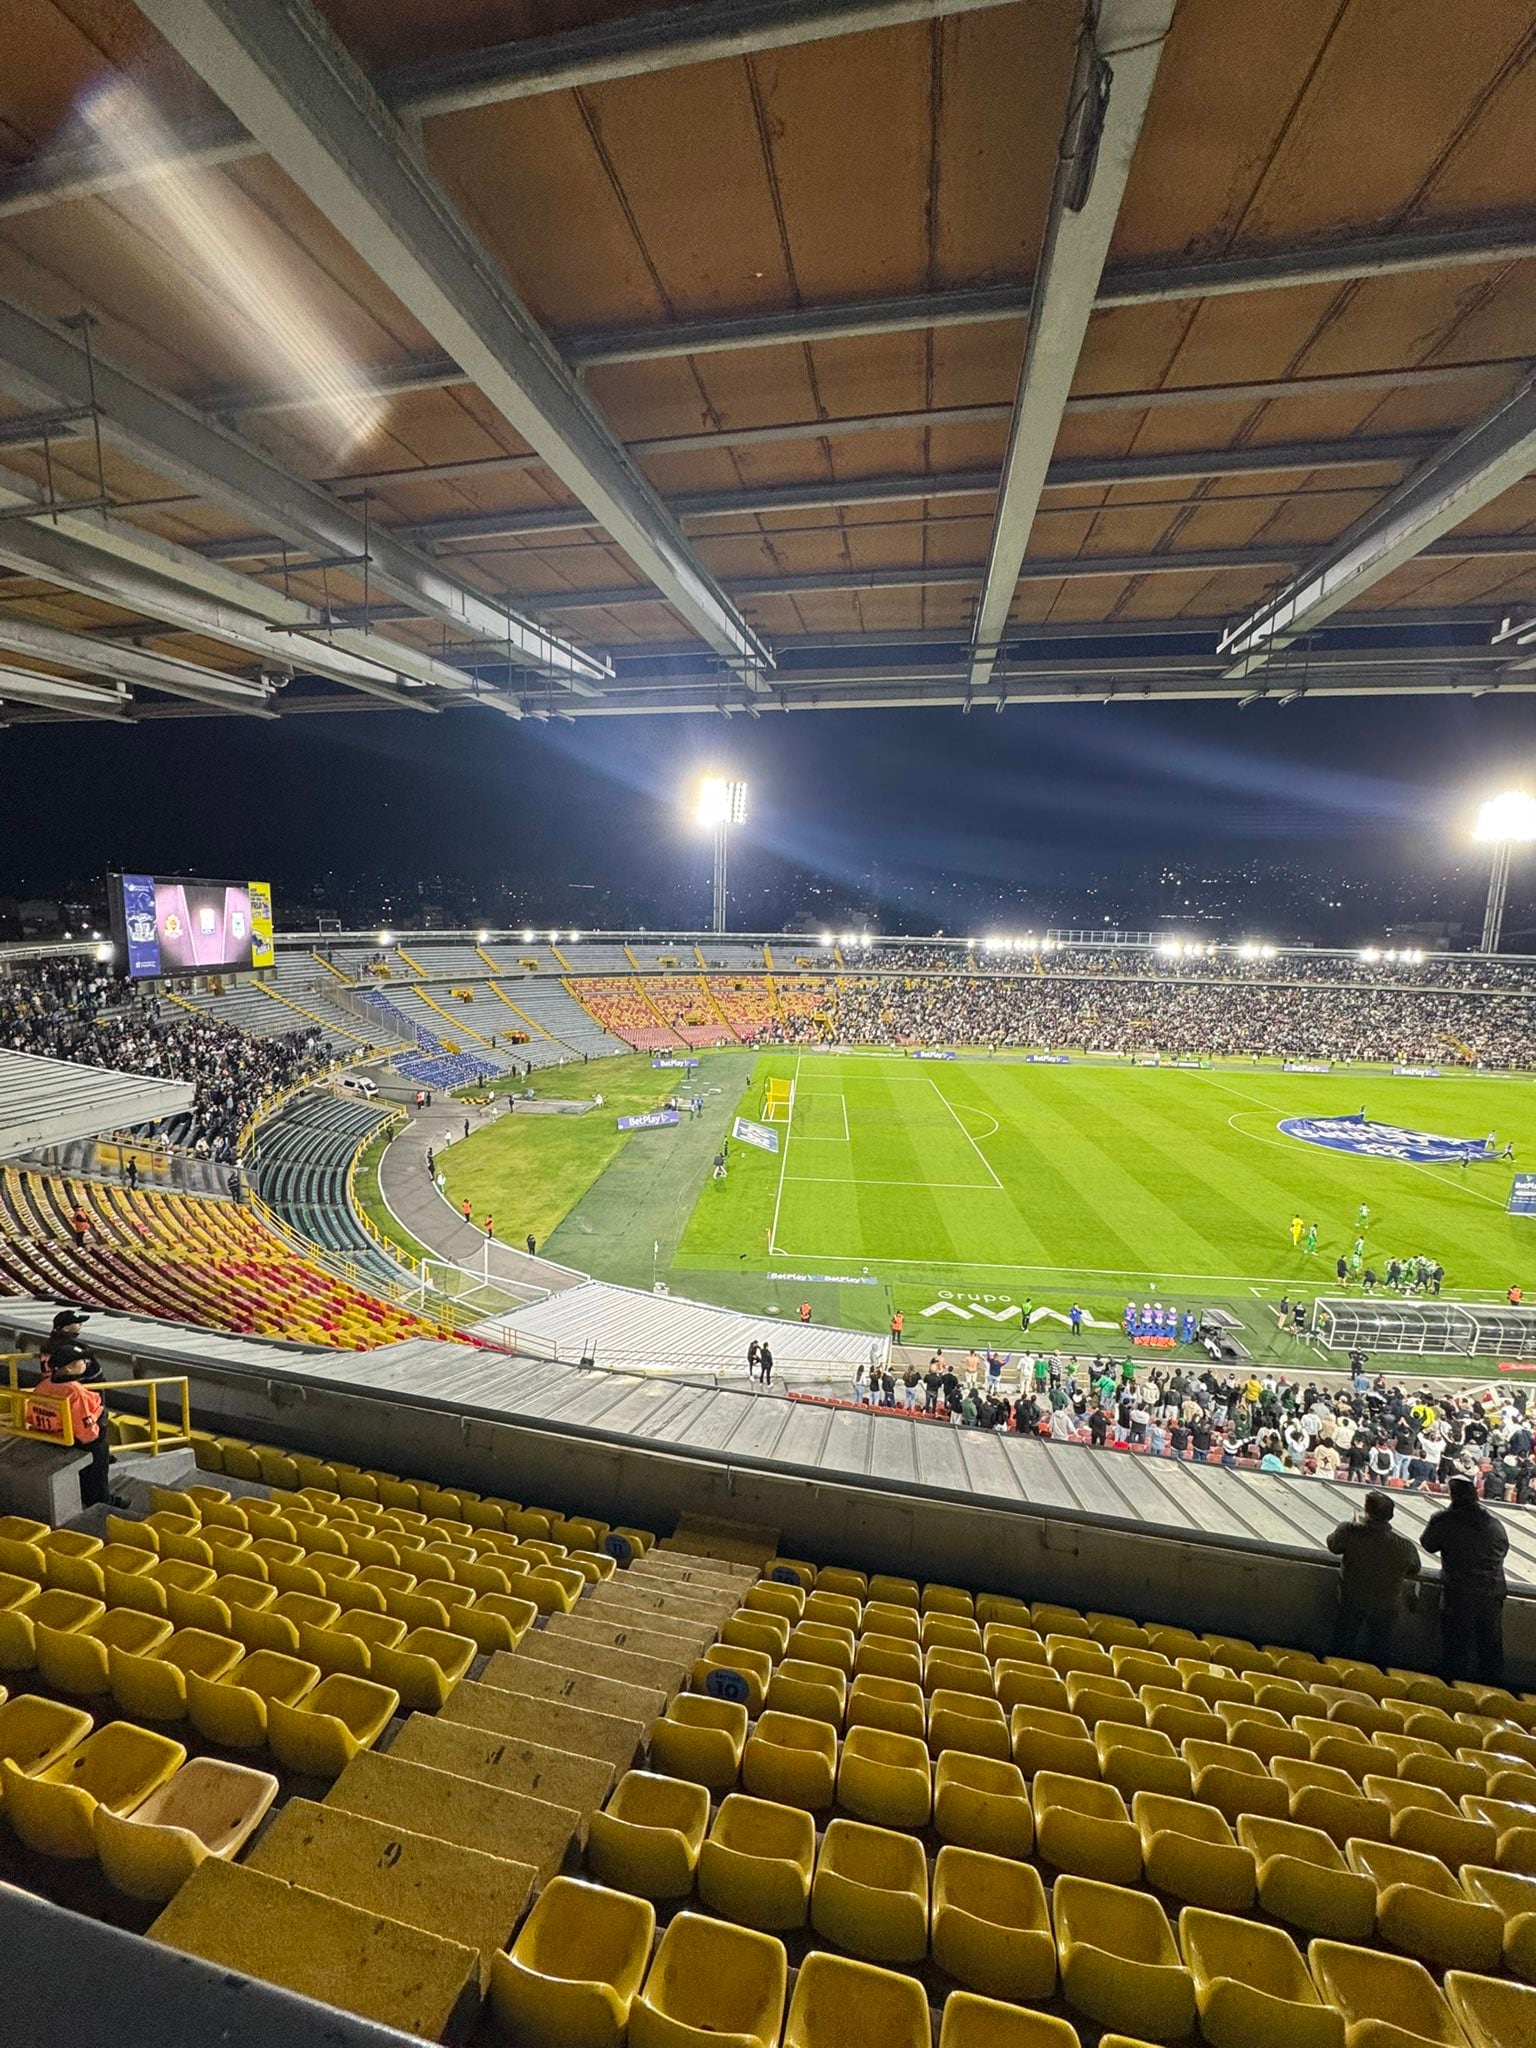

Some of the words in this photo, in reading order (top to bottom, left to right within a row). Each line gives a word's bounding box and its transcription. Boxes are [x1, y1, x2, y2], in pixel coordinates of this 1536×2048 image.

[660, 1059, 684, 1067] BetPlay
[629, 1114, 660, 1126] BetPlay
[771, 1272, 806, 1281] BetPlay
[824, 1275, 860, 1284] BetPlay
[938, 1290, 1011, 1303] Grupo
[716, 1680, 739, 1698] 10
